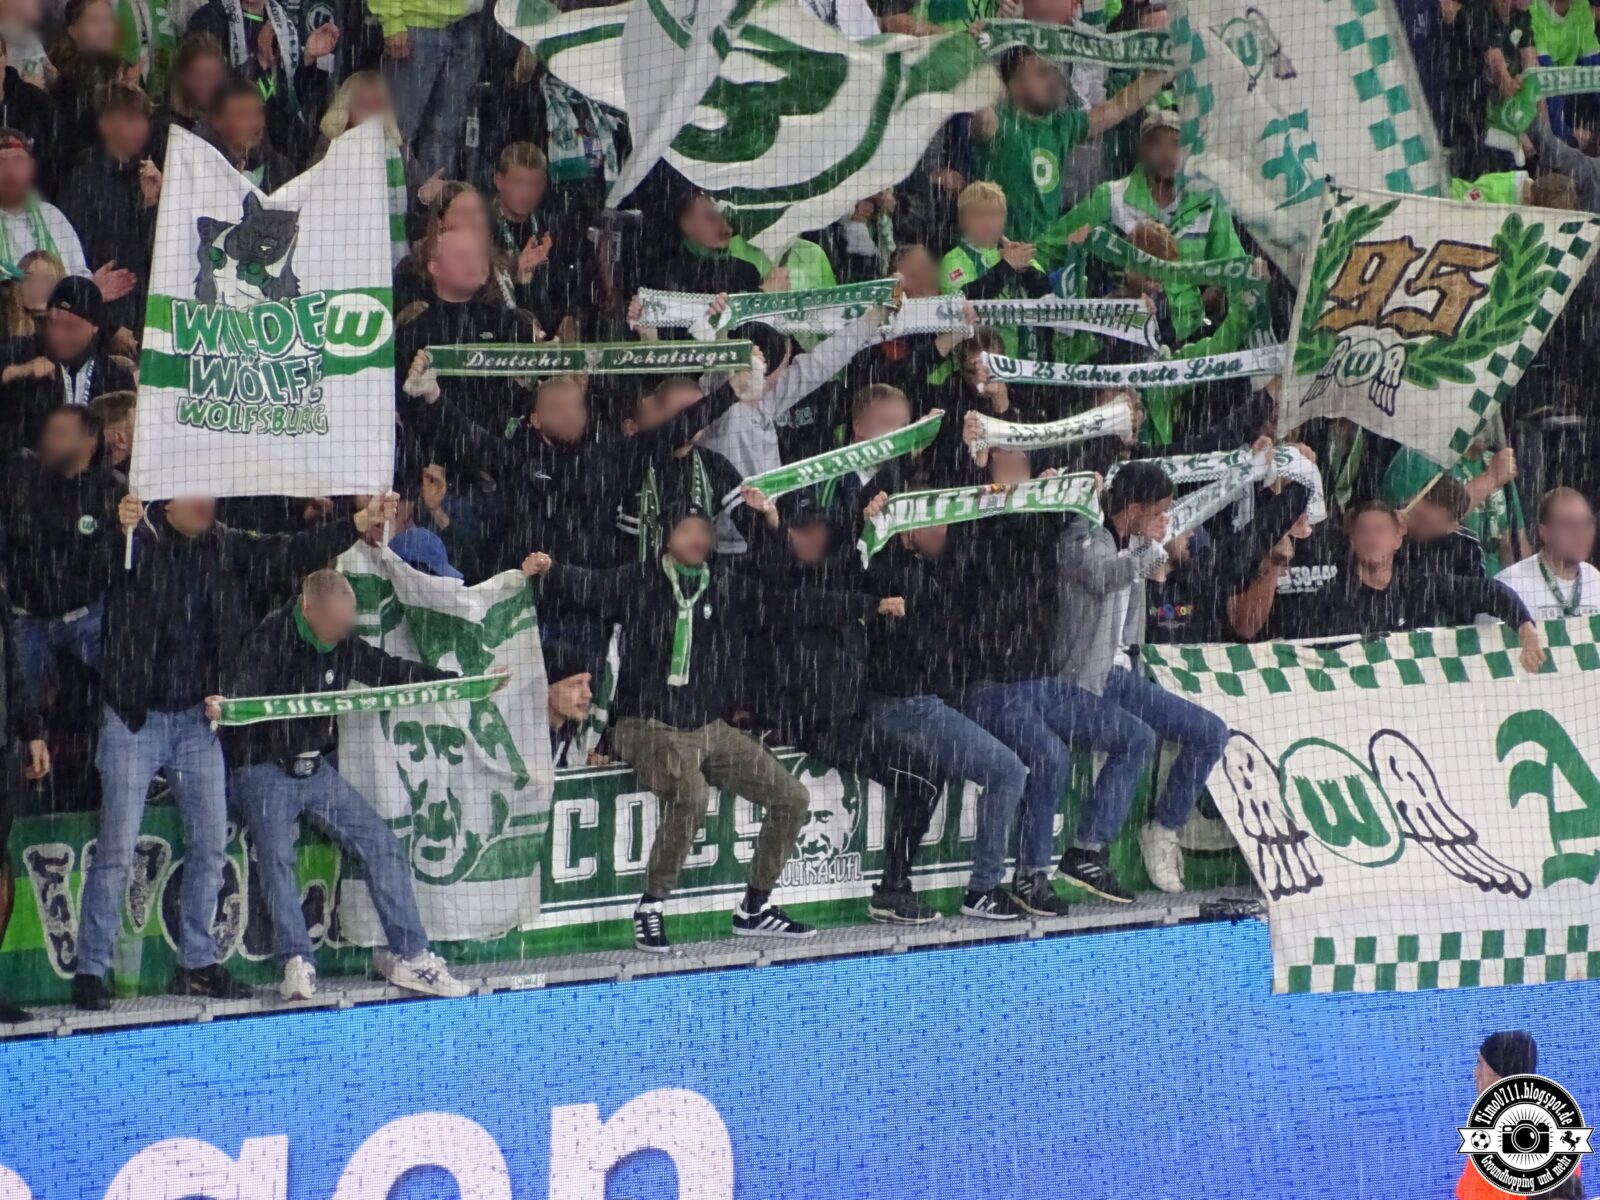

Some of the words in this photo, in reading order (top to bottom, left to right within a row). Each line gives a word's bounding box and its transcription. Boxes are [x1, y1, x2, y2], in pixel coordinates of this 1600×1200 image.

[1311, 235, 1501, 340] 95
[171, 291, 326, 357] WILDE
[189, 352, 323, 404] WÖLFE
[463, 351, 571, 368] Deutscher
[613, 349, 738, 367] Pokalsieger
[1033, 361, 1055, 379] 25
[1062, 362, 1121, 382] Jahre
[1128, 365, 1178, 382] erste
[1184, 357, 1242, 380] Liga
[176, 396, 329, 437] WOLFSBURG
